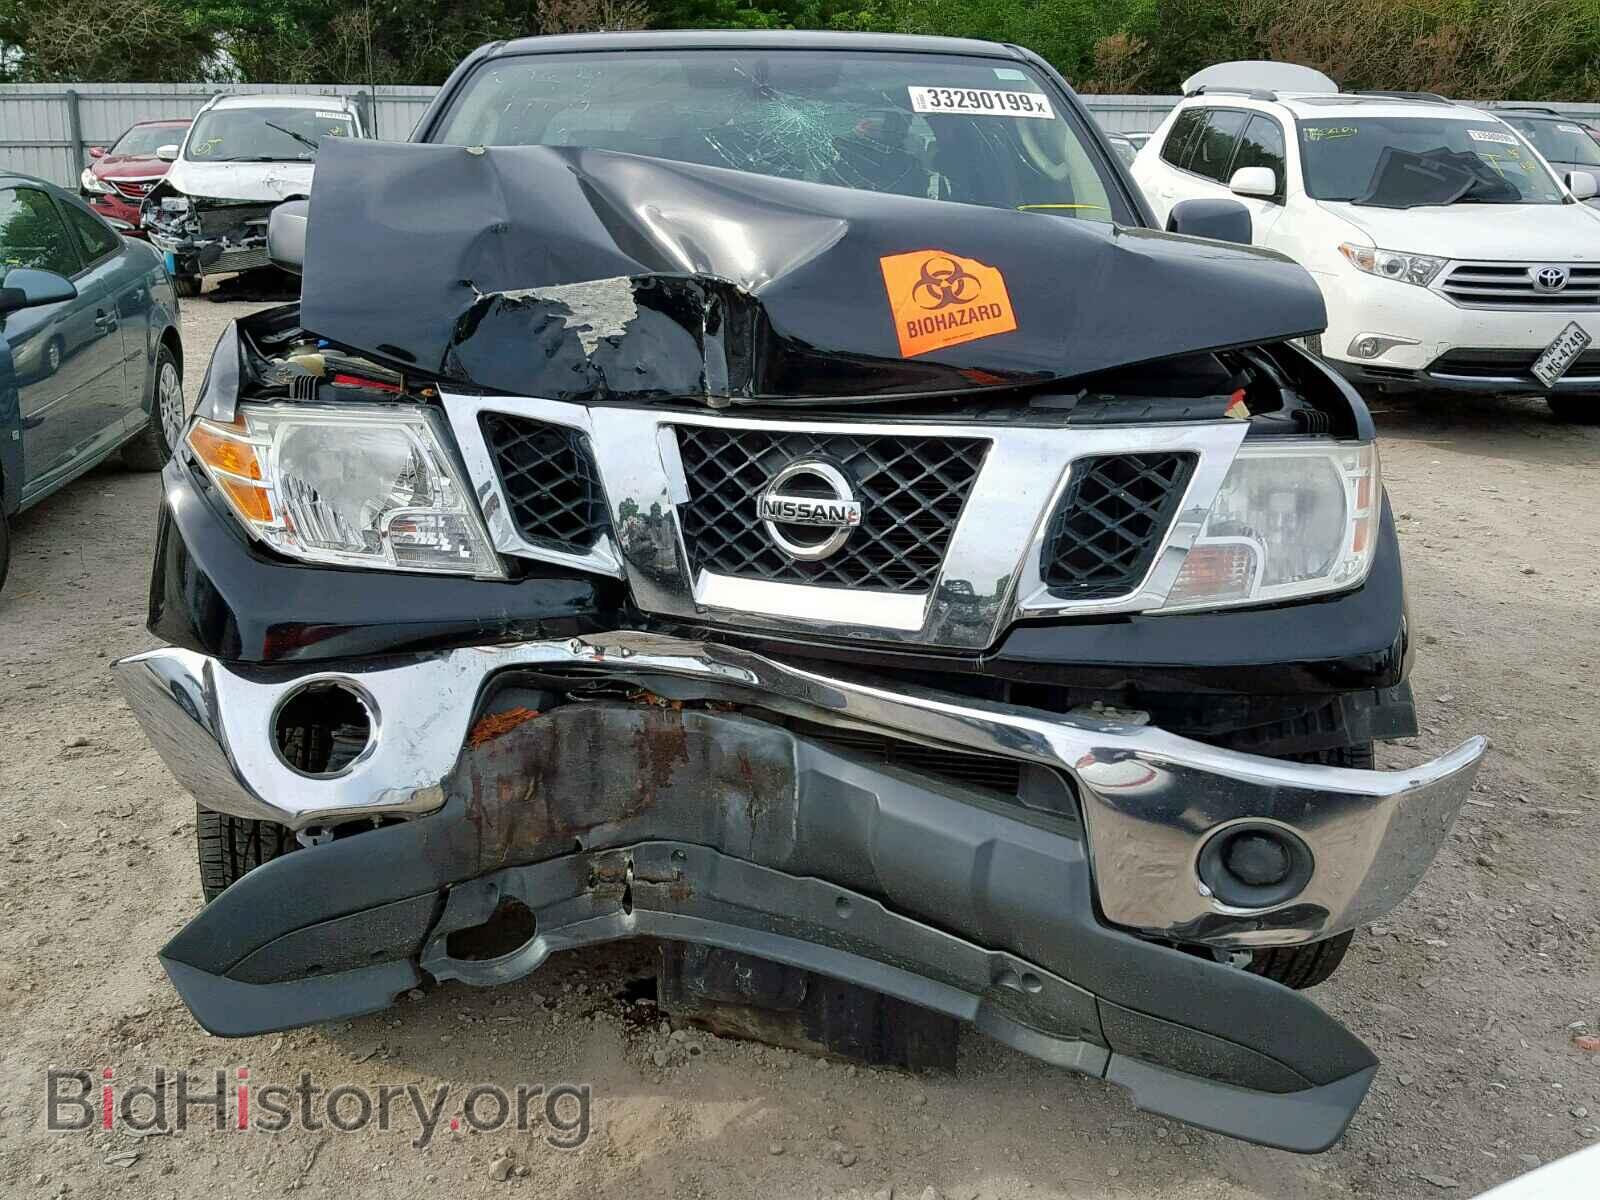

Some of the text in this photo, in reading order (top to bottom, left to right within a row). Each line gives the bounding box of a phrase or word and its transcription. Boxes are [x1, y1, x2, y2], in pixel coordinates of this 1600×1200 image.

[927, 89, 1034, 112] 33290199
[906, 302, 1003, 339] BIOHAZARD
[763, 500, 847, 521] NISSAN
